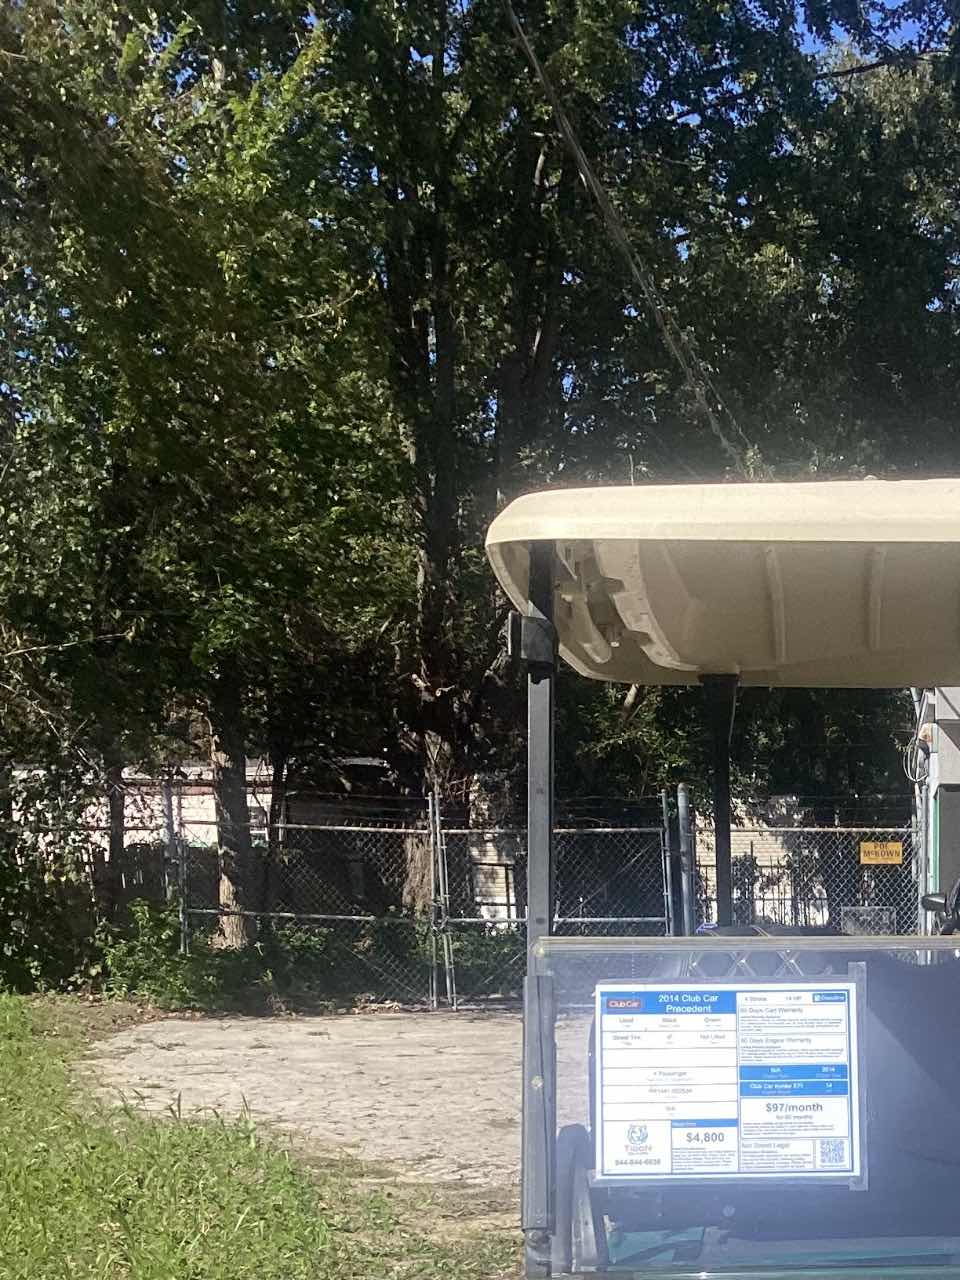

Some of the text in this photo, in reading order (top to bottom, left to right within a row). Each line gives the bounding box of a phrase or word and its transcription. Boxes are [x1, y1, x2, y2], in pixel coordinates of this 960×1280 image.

[658, 994, 719, 1003] 2014 Club Car
[608, 1000, 641, 1008] Club Car
[665, 1004, 712, 1013] Precedent
[765, 1102, 824, 1113] $97/month
[686, 1132, 725, 1143] $4,800
